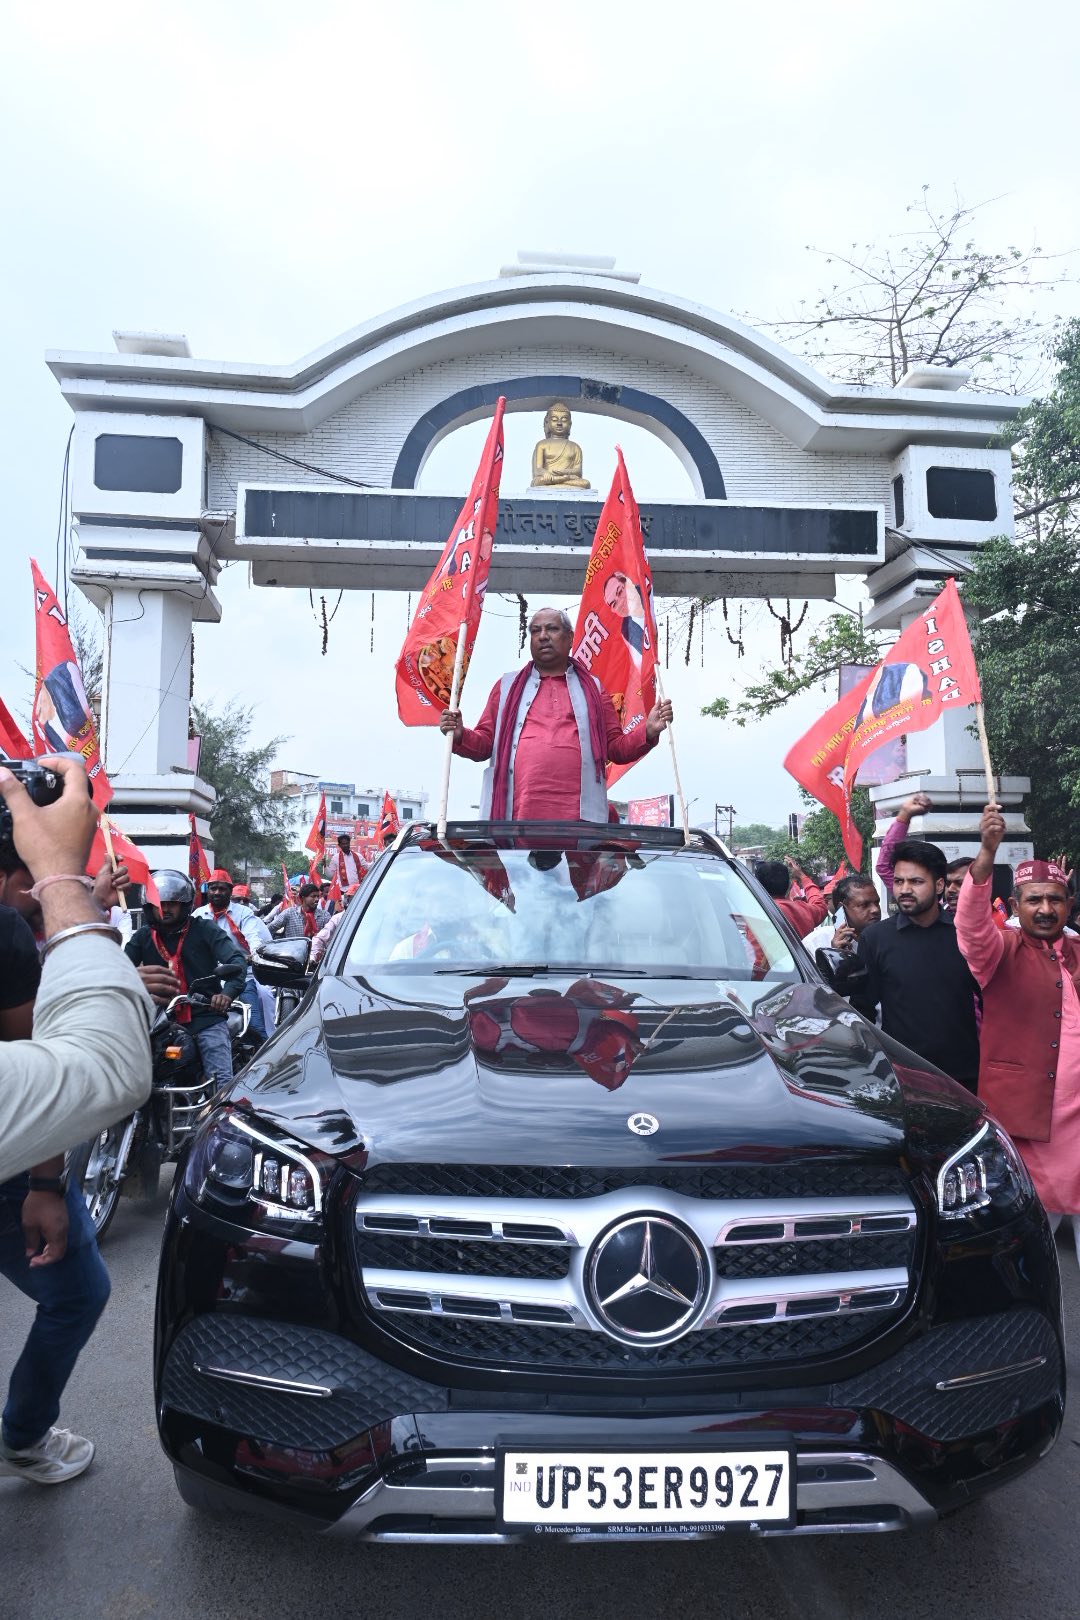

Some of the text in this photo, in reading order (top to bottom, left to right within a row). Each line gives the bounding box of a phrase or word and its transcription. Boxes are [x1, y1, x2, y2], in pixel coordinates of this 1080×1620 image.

[510, 1481, 531, 1492] IND
[536, 1465, 783, 1509] UP53ER9927
[544, 1525, 591, 1533] Mercedes-Benz
[607, 1525, 623, 1533] SRM
[624, 1525, 637, 1533] Star
